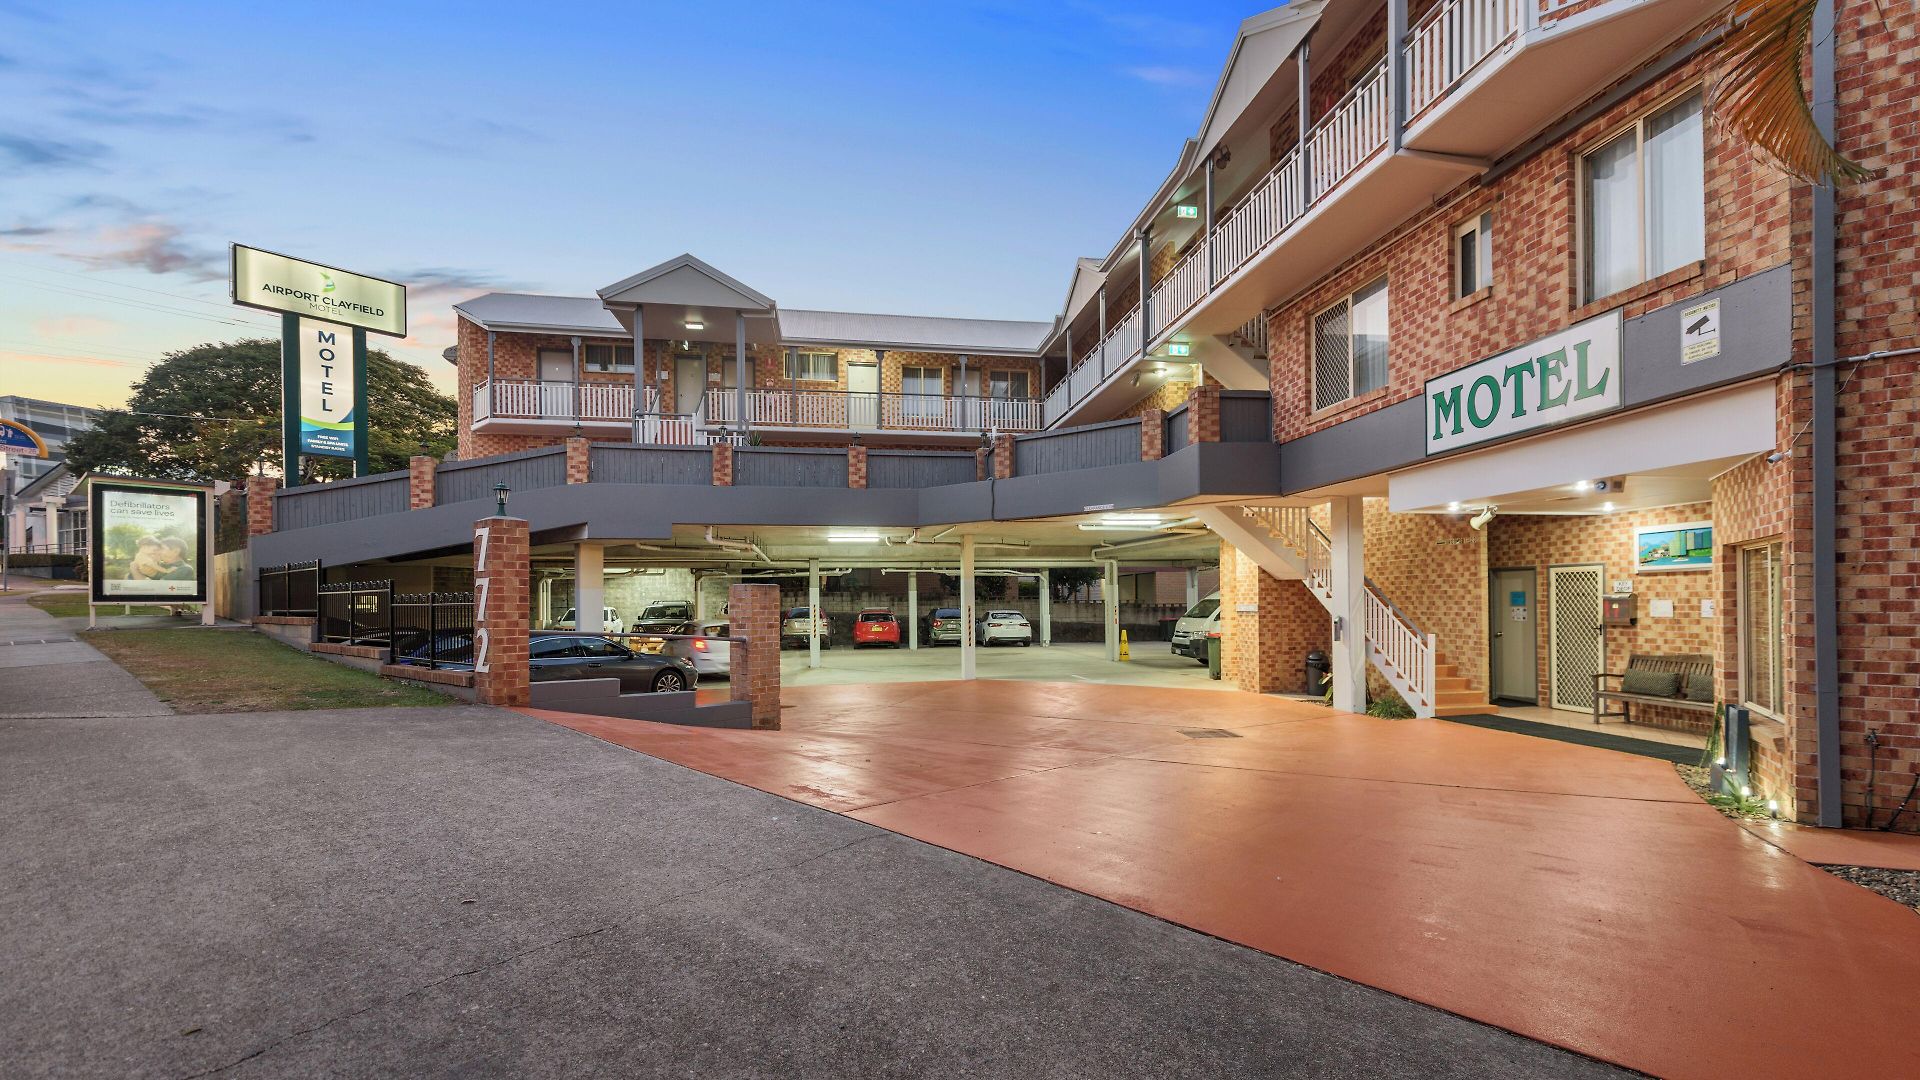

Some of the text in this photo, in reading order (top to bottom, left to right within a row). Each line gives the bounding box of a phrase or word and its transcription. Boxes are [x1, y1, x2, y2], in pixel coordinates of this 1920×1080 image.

[262, 283, 385, 317] AIRPORT CLAYFIELD
[309, 302, 343, 316] MOTEL
[318, 330, 336, 412] MOTEL
[1432, 339, 1610, 441] MOTEL
[110, 500, 170, 510] Defibrillators
[474, 527, 490, 674] 772
